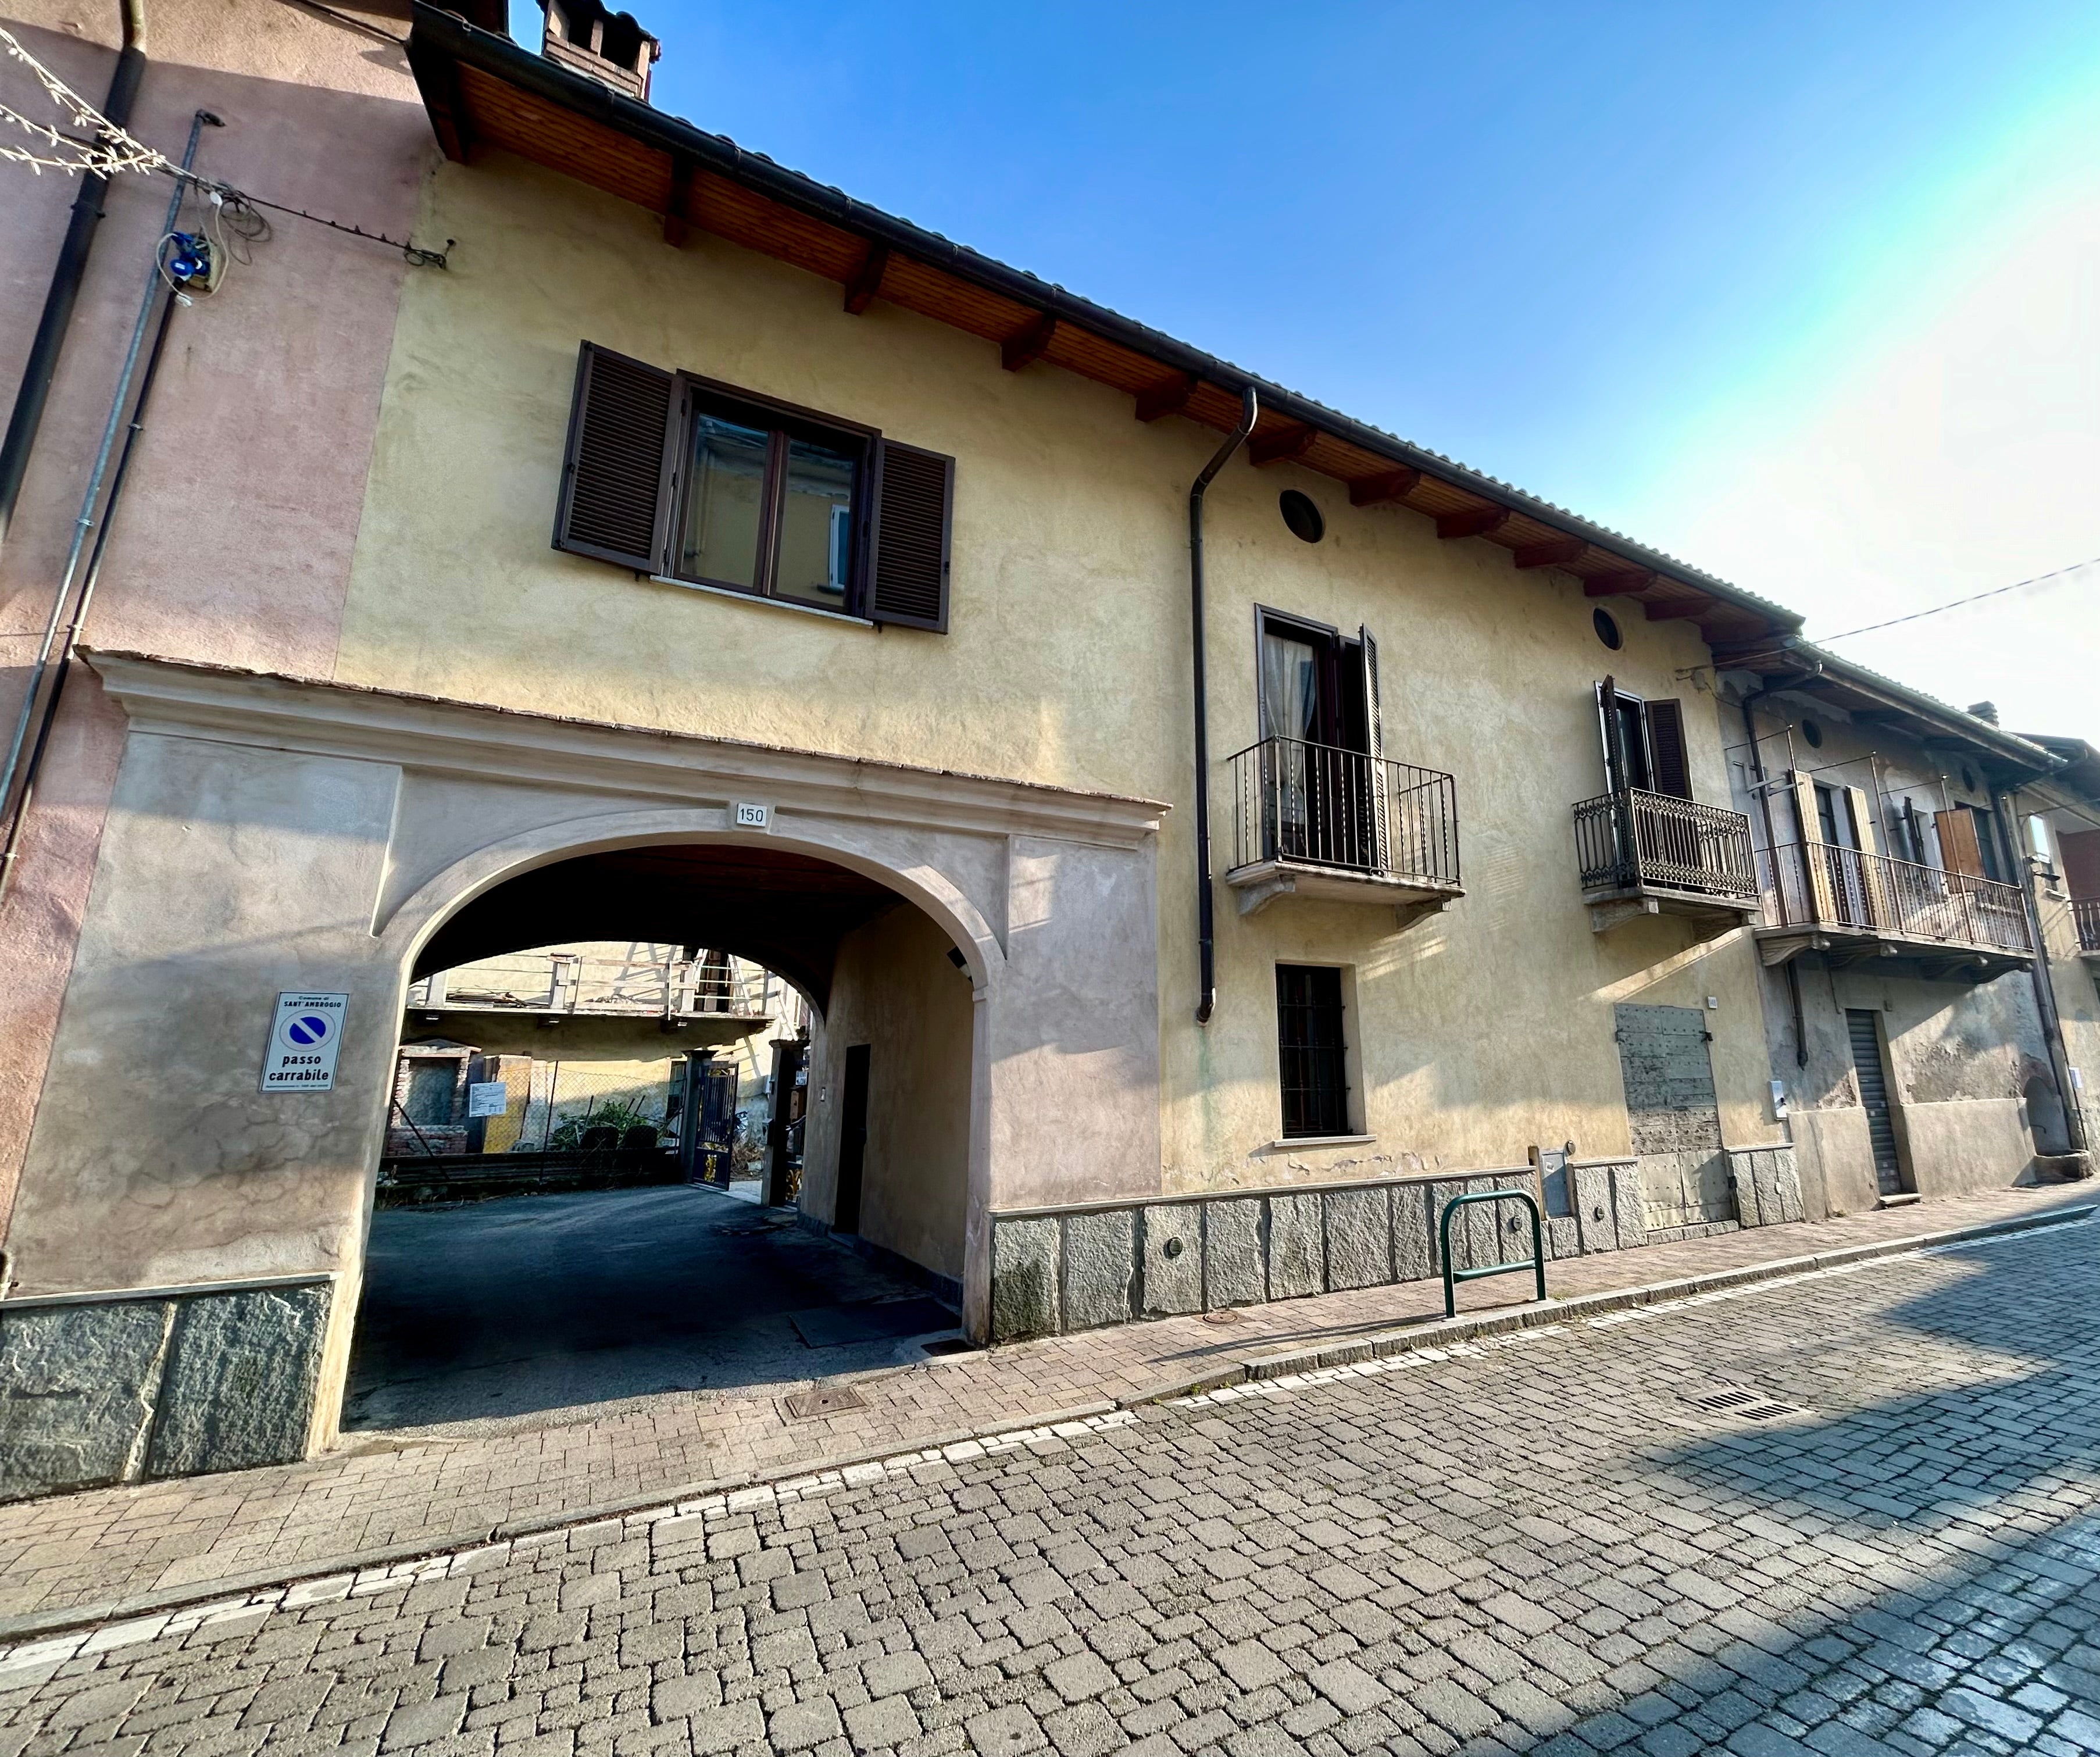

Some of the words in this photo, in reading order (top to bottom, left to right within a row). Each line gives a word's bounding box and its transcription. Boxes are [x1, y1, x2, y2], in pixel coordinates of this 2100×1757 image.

[740, 808, 763, 822] 150
[282, 1056, 322, 1067] passo
[269, 1069, 329, 1081] carrabile
